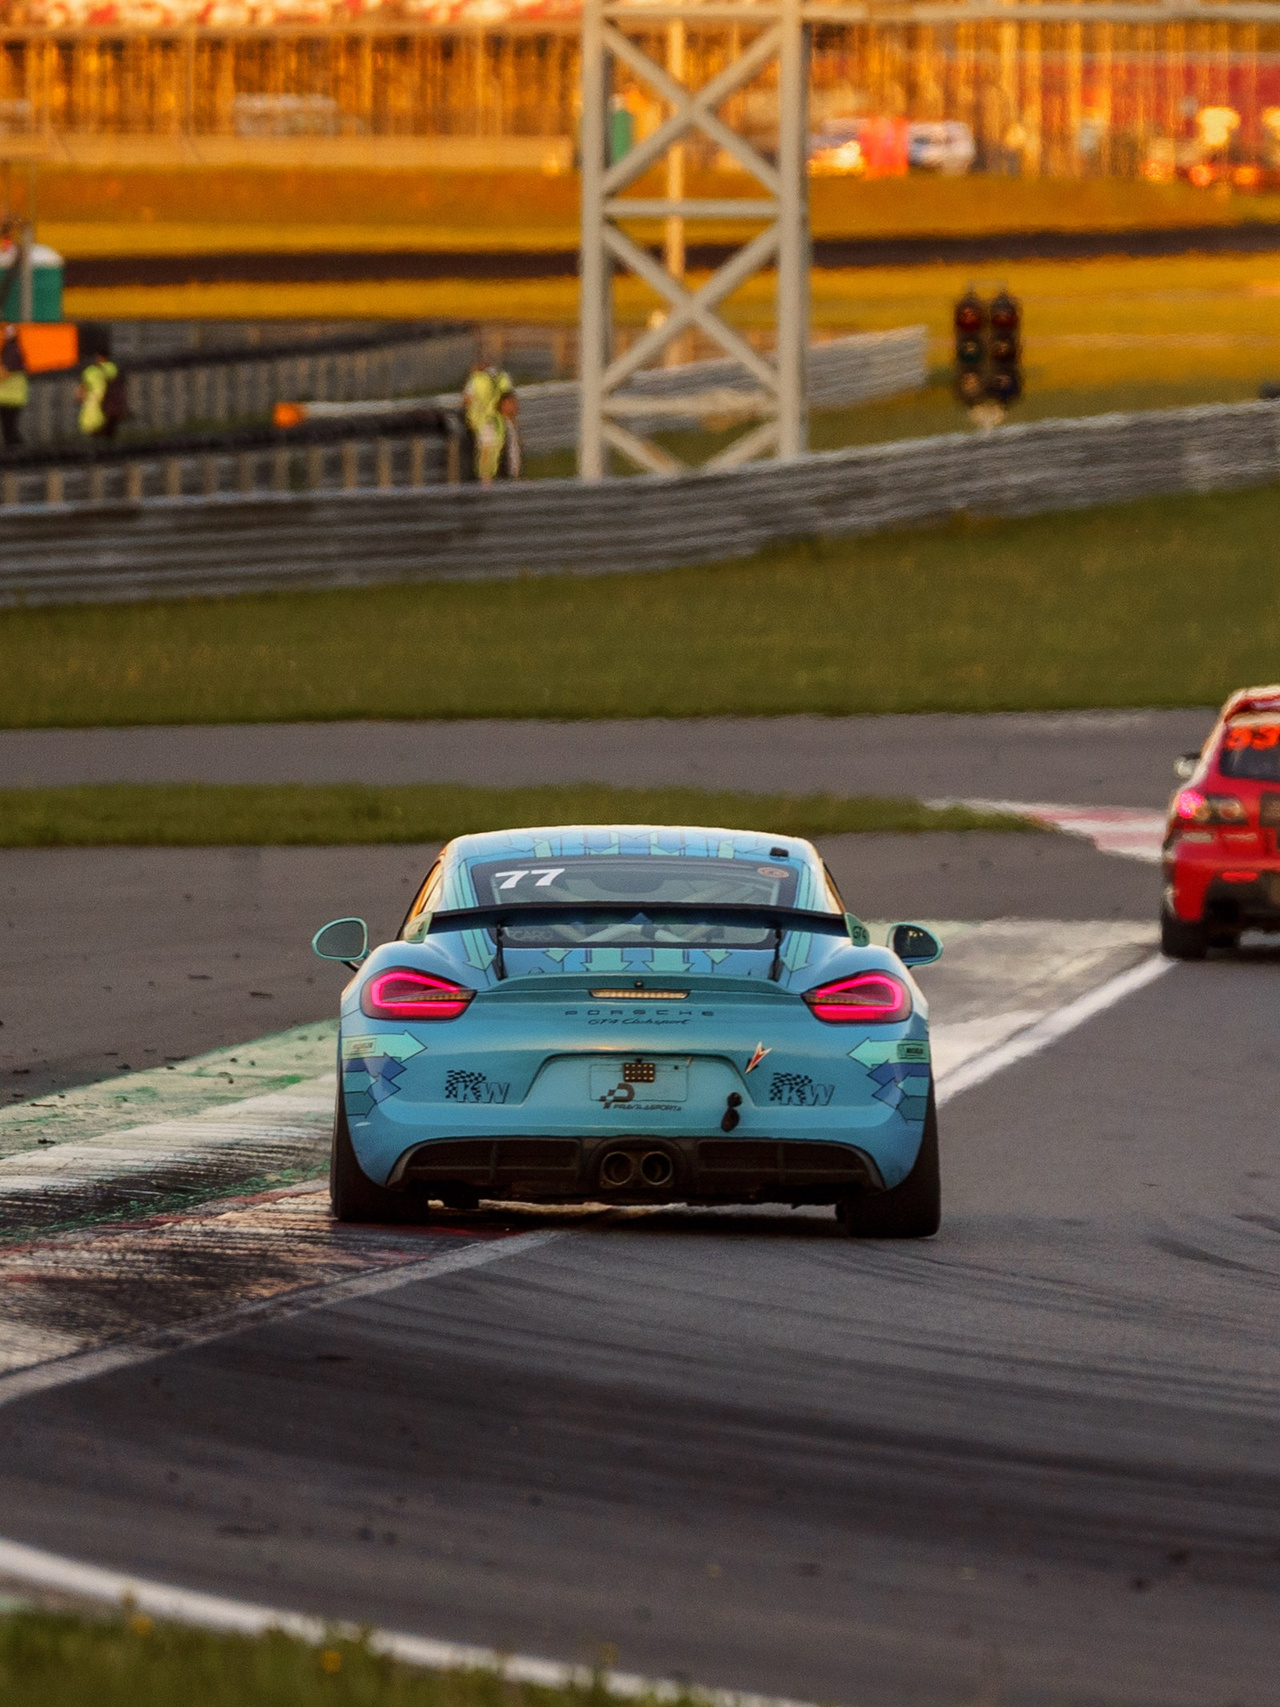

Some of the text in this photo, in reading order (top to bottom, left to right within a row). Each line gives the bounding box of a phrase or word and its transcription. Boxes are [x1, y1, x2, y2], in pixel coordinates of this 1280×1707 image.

[494, 867, 566, 890] 77
[564, 1009, 715, 1017] PORSCHE
[621, 1017, 692, 1026] Clubsport
[455, 1081, 510, 1104] KW
[780, 1083, 835, 1107] KW
